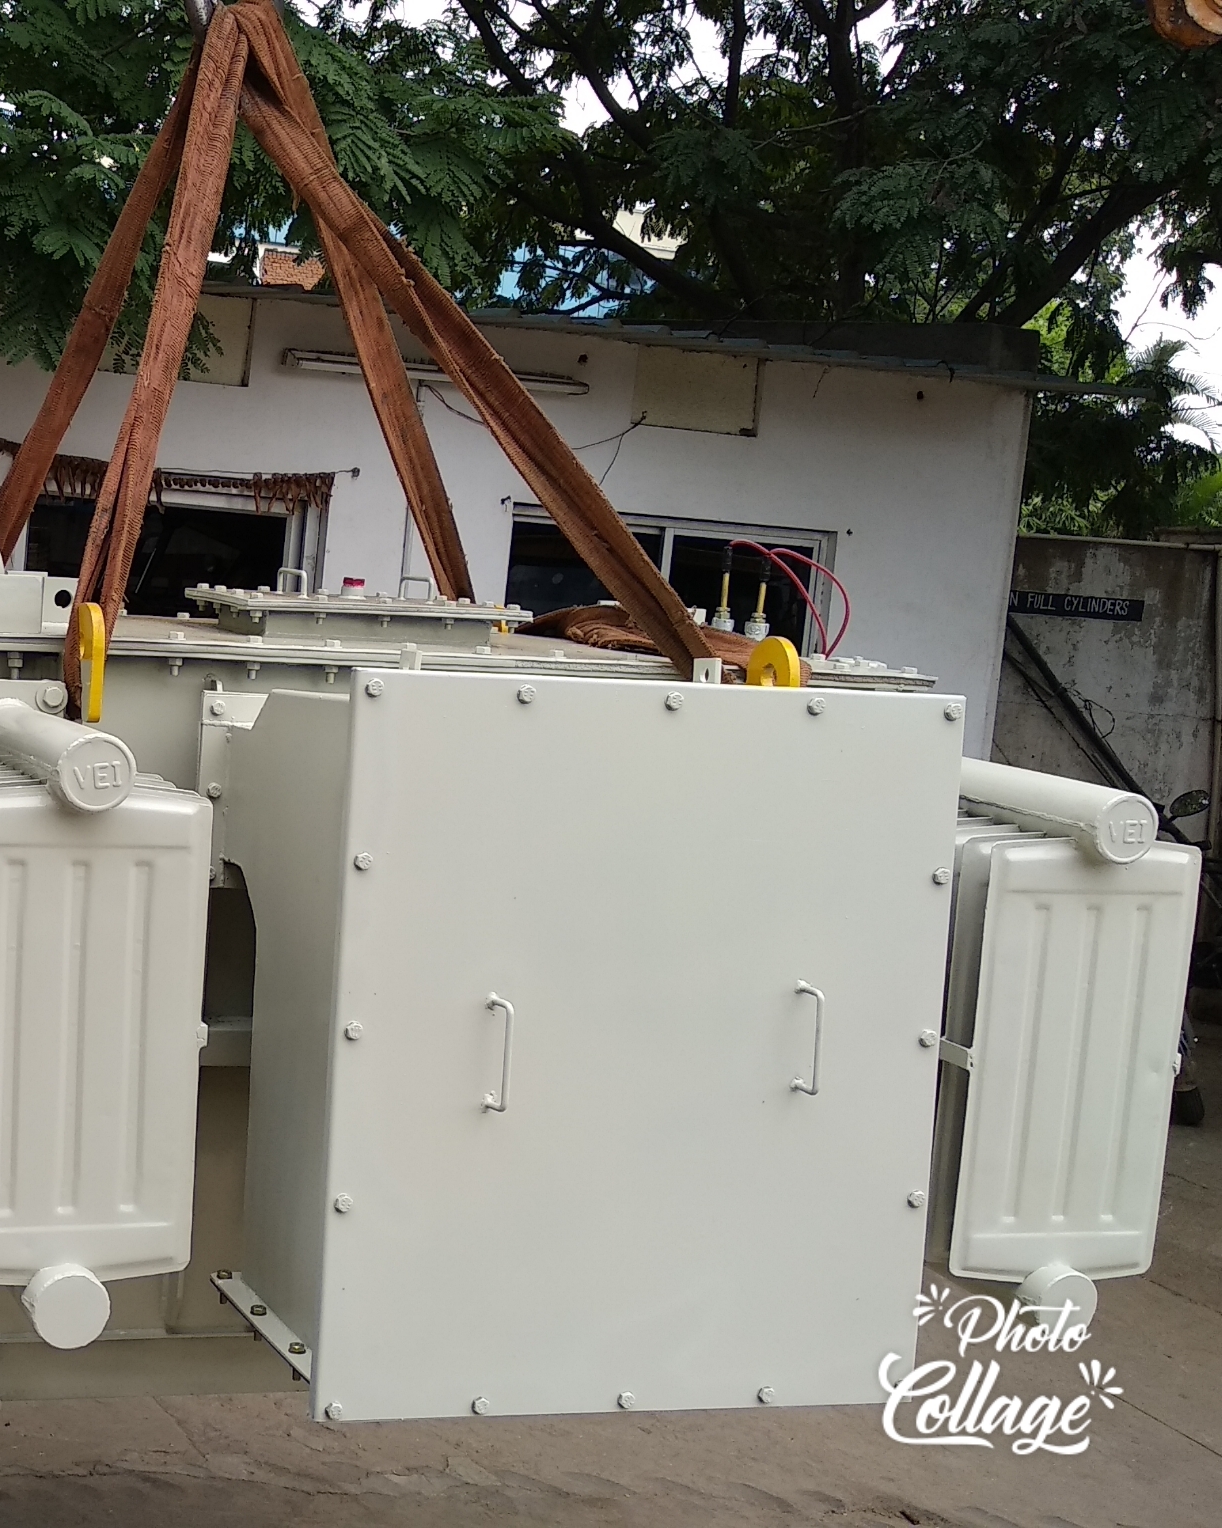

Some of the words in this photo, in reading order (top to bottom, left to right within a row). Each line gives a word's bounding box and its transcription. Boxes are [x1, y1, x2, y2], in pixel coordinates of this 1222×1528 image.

[1027, 593, 1056, 611] FULL
[1064, 596, 1130, 616] CYLINDERS
[73, 760, 122, 790] VEI
[1109, 819, 1148, 845] VEI
